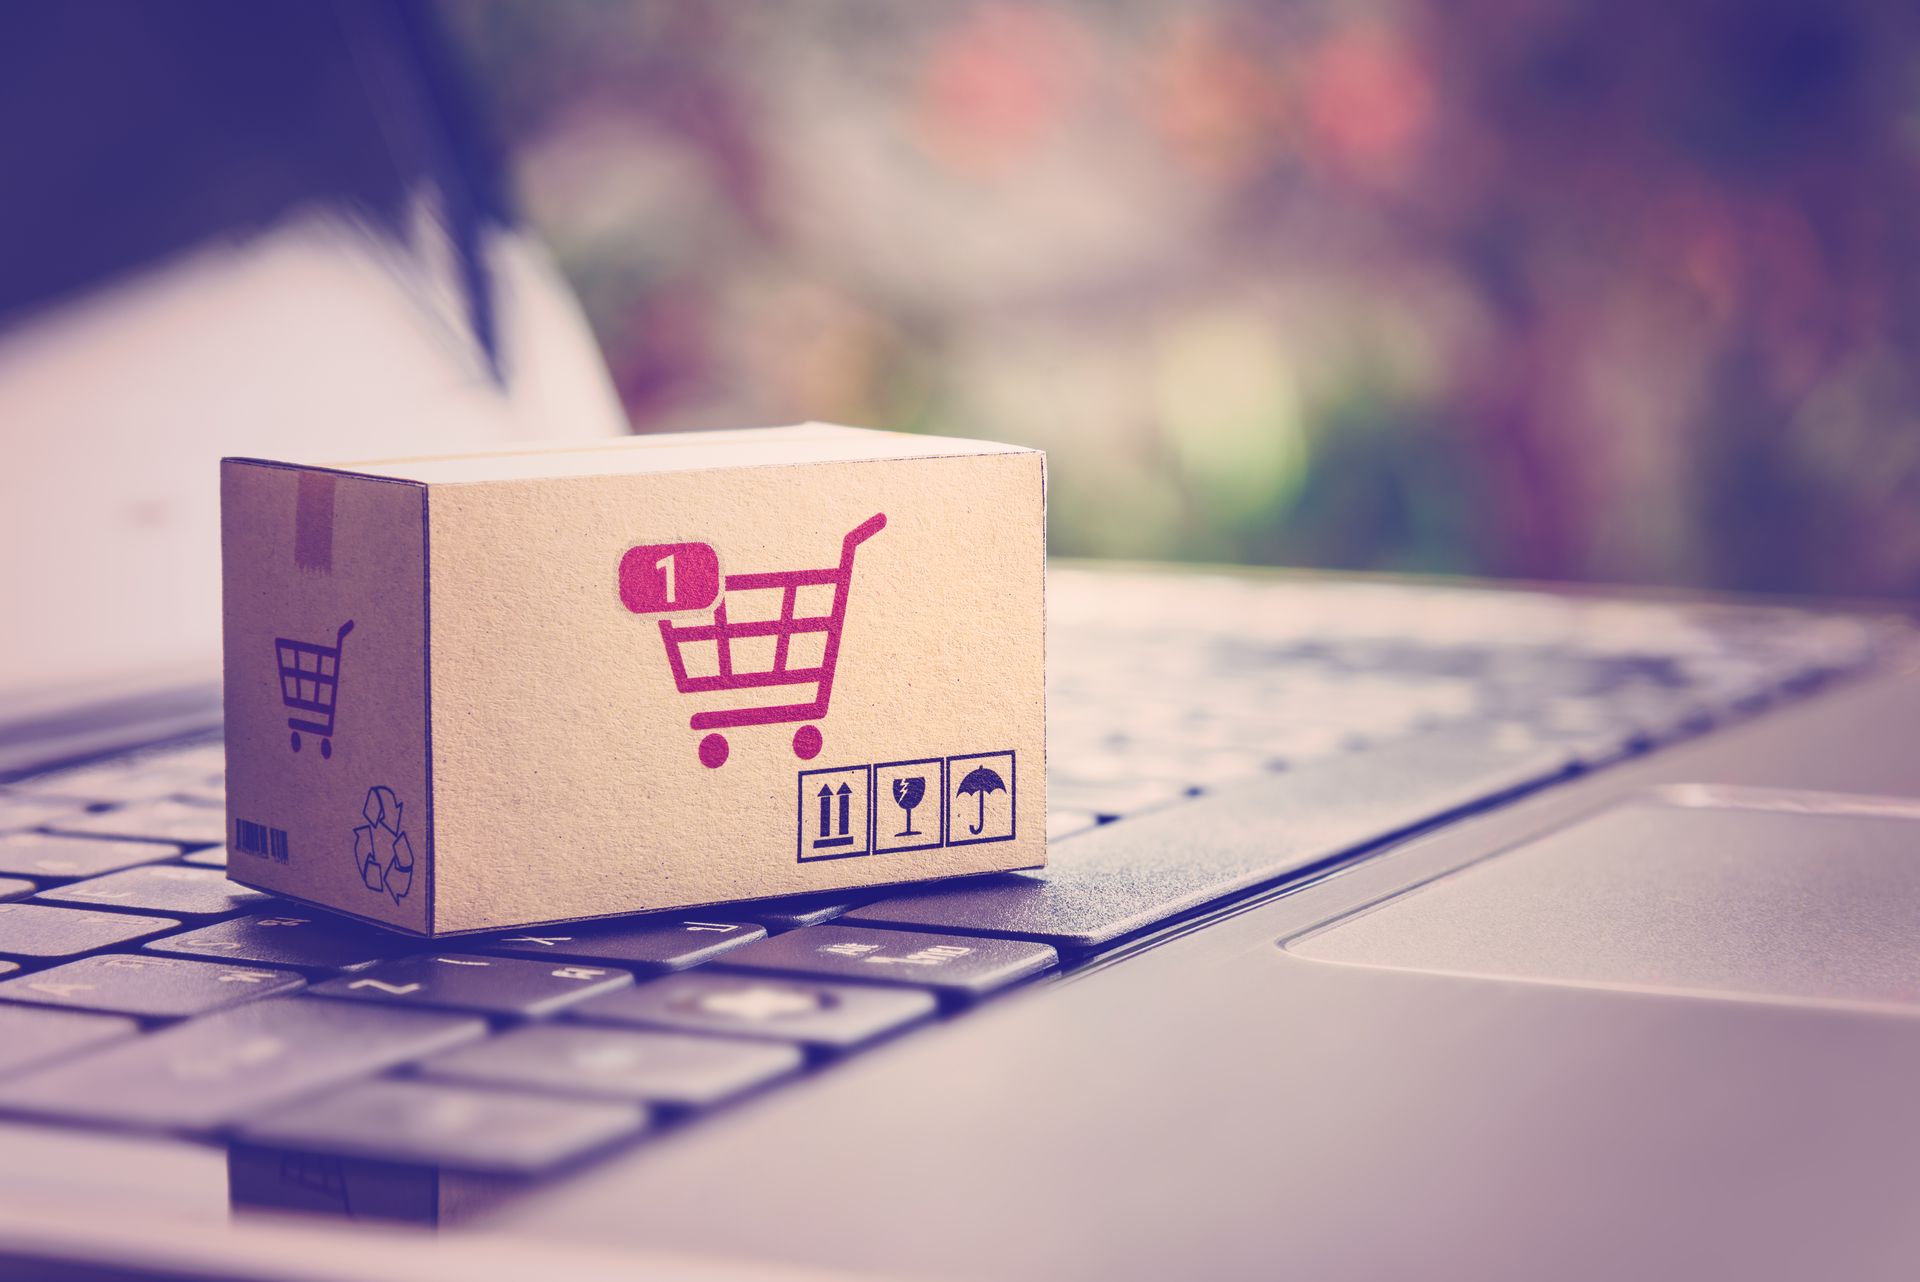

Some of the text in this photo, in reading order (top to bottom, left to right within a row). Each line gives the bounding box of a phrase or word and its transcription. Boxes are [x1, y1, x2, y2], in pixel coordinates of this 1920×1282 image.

[655, 554, 676, 603] 1
[502, 934, 572, 946] X
[348, 978, 421, 995] Z
